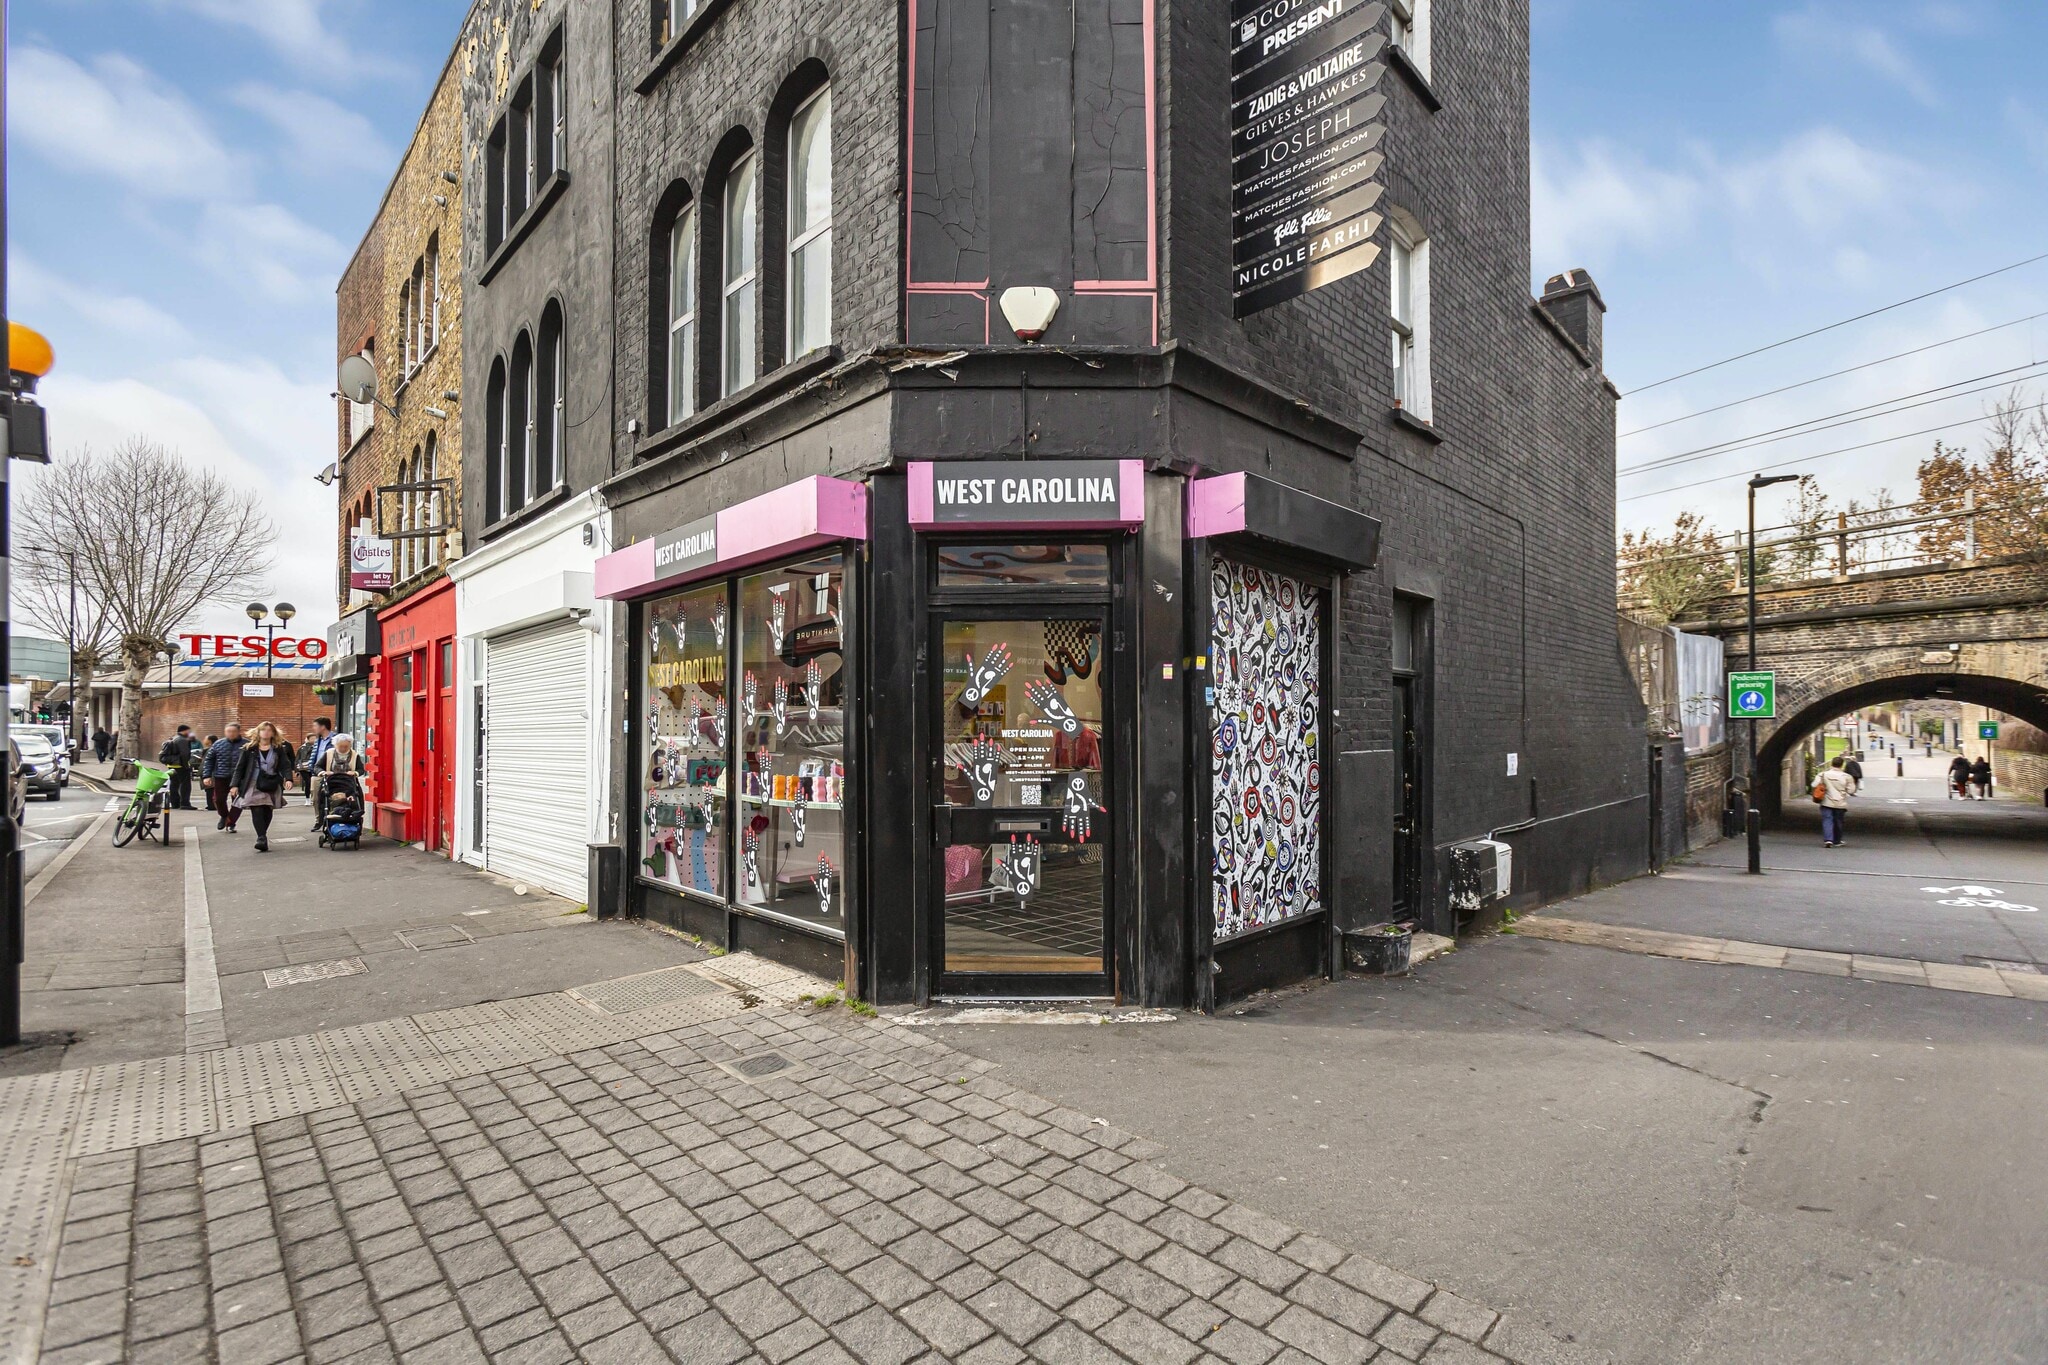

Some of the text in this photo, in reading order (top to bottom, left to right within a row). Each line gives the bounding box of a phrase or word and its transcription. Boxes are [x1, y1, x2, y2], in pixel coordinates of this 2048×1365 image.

[1263, 0, 1342, 56] PRESENT
[1246, 69, 1367, 140] GIEVES & HAWKES
[1260, 108, 1350, 170] JOSEPH
[937, 478, 1116, 504] WEST CAROLINA
[354, 545, 391, 561] Castles
[655, 529, 716, 568] WEST CAROLINA
[179, 633, 327, 659] TESCO
[648, 655, 725, 688] WEST CAROLINA
[1001, 729, 1054, 738] WEST CAROLINA
